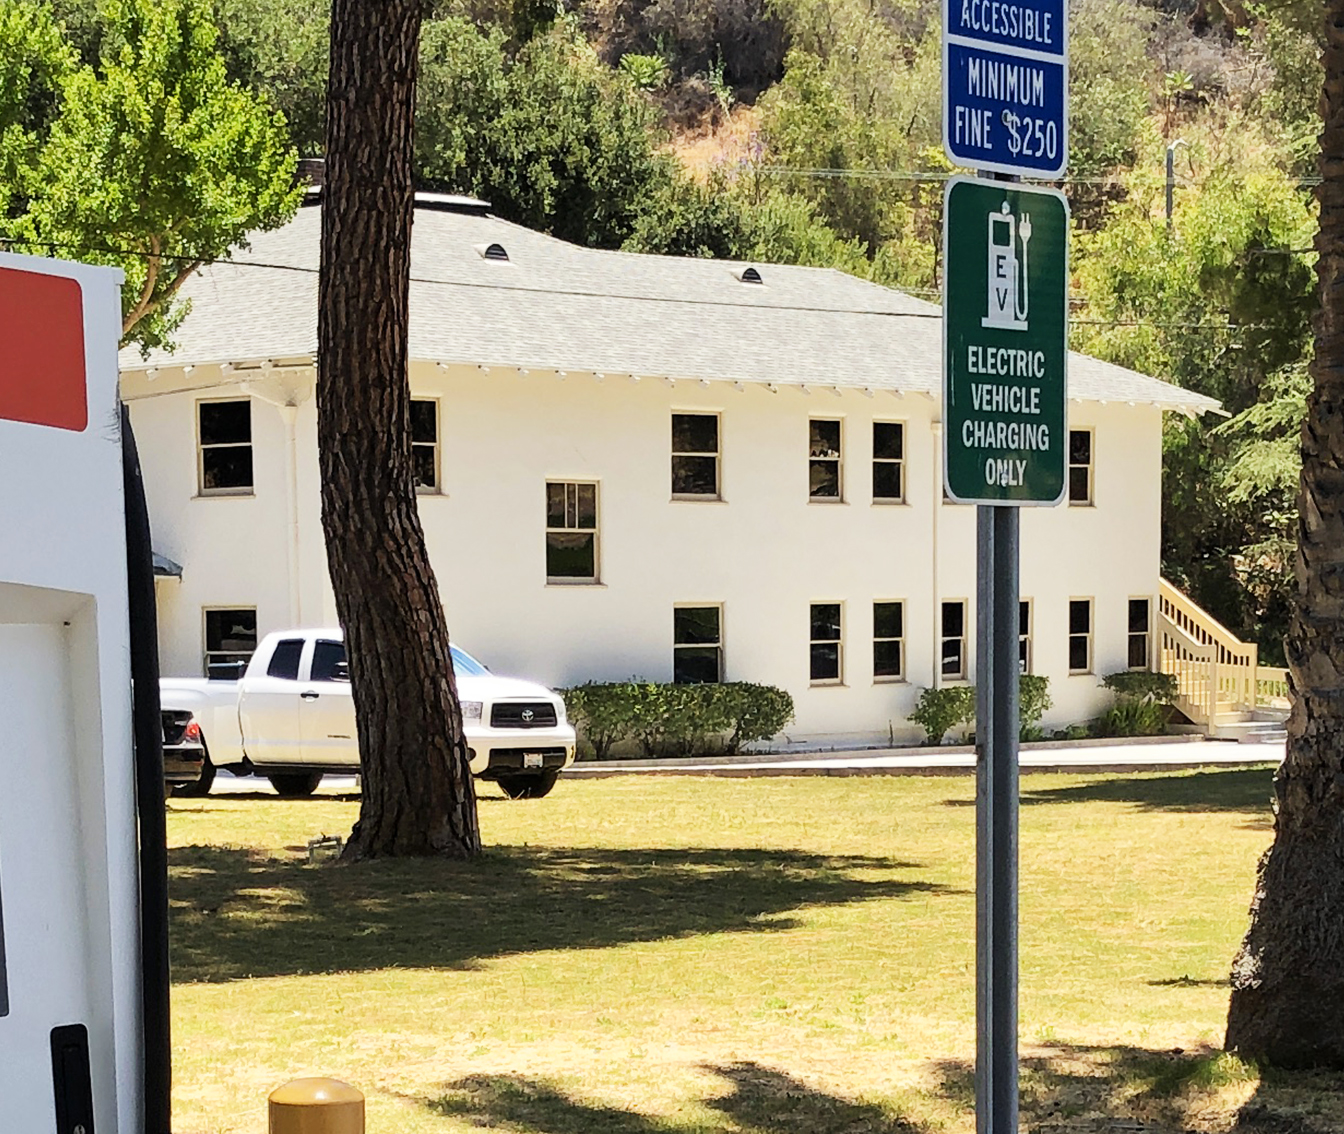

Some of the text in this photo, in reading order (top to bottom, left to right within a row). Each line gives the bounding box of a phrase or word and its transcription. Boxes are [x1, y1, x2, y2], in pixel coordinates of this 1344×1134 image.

[960, 0, 1053, 44] ACCESSIBLE
[968, 56, 1044, 108] MINIMUM
[955, 105, 1057, 160] FINE $250
[967, 345, 1045, 378] ELECTRIC
[970, 383, 1041, 415] VEHICLE
[962, 419, 1050, 451] CHARGING
[985, 458, 1027, 487] ONLY
